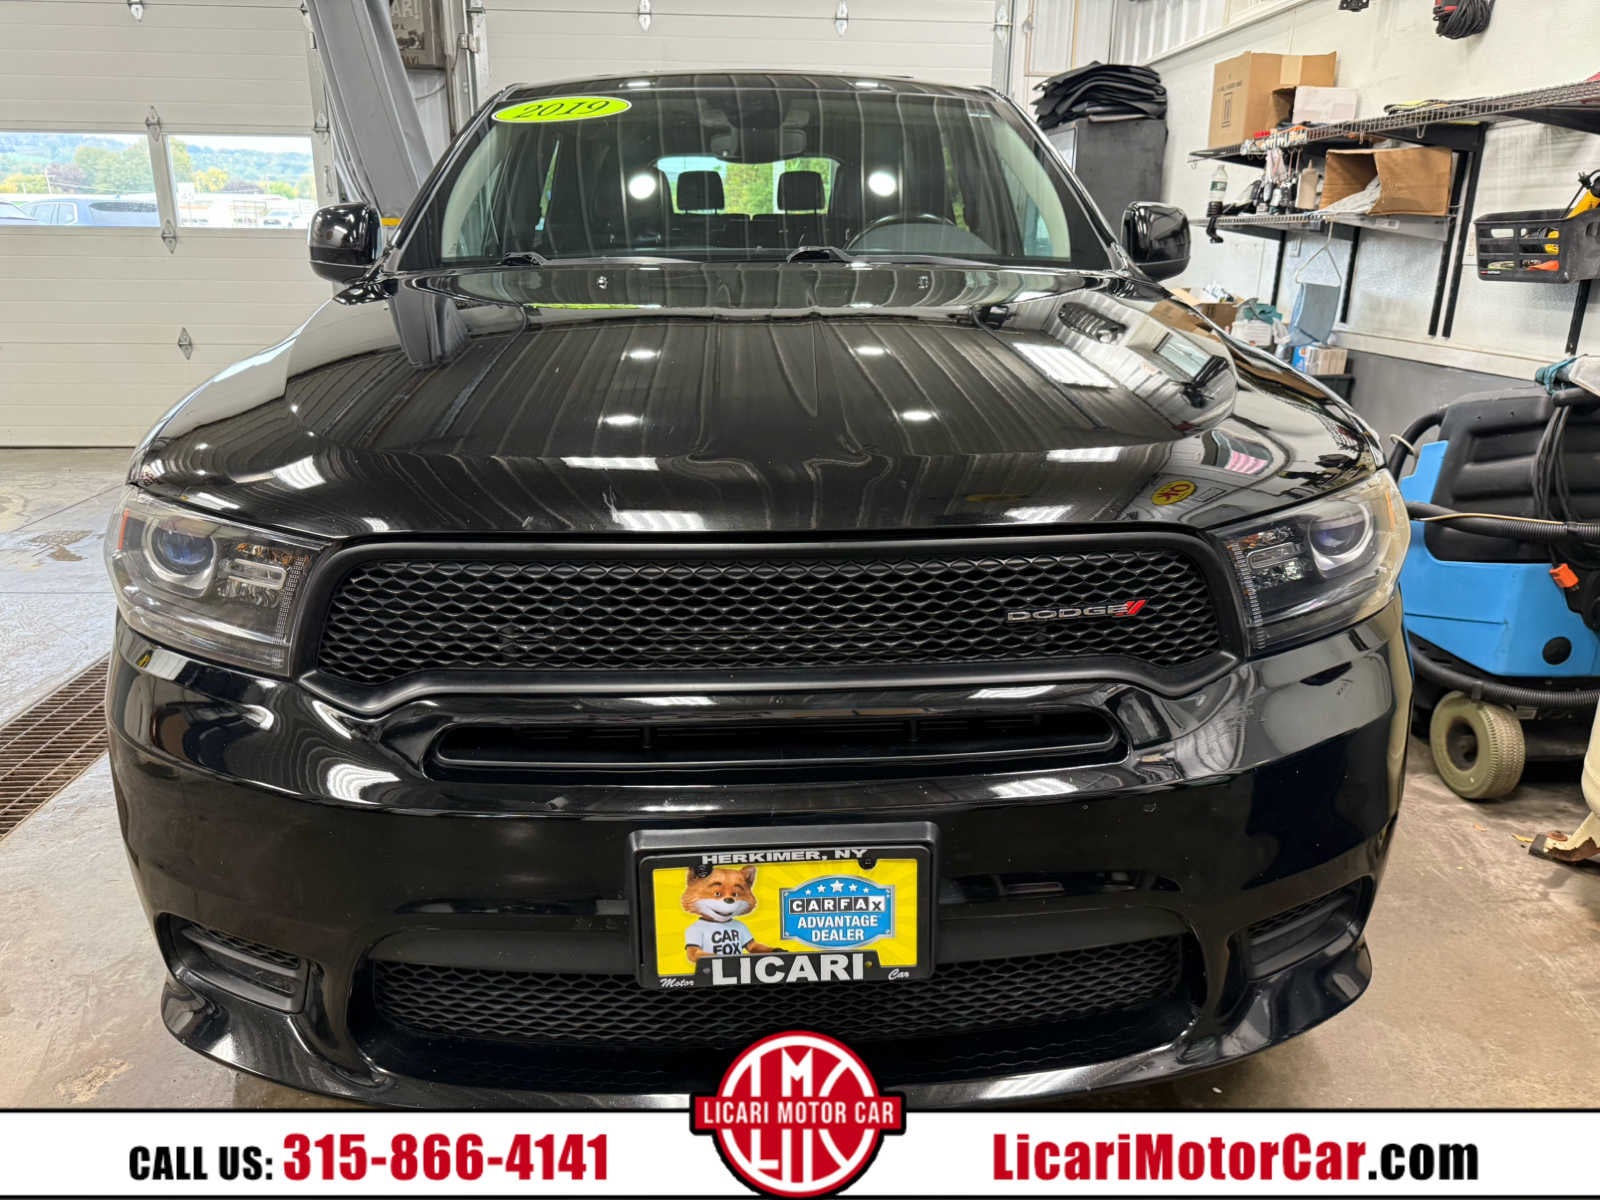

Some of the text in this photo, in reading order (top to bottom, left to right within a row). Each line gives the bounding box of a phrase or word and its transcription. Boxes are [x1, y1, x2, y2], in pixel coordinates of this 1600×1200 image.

[514, 100, 611, 118] 2019
[1007, 603, 1130, 622] DODGE
[702, 848, 868, 865] HERKIMER, NY
[791, 898, 884, 912] CARFAX
[797, 914, 879, 929] ADVANTAGE
[711, 929, 740, 944] CAR
[811, 928, 865, 942] DEALER
[713, 942, 742, 955] FOX
[711, 953, 864, 986] LICARI
[887, 968, 910, 980] Car
[660, 977, 695, 988] Motor
